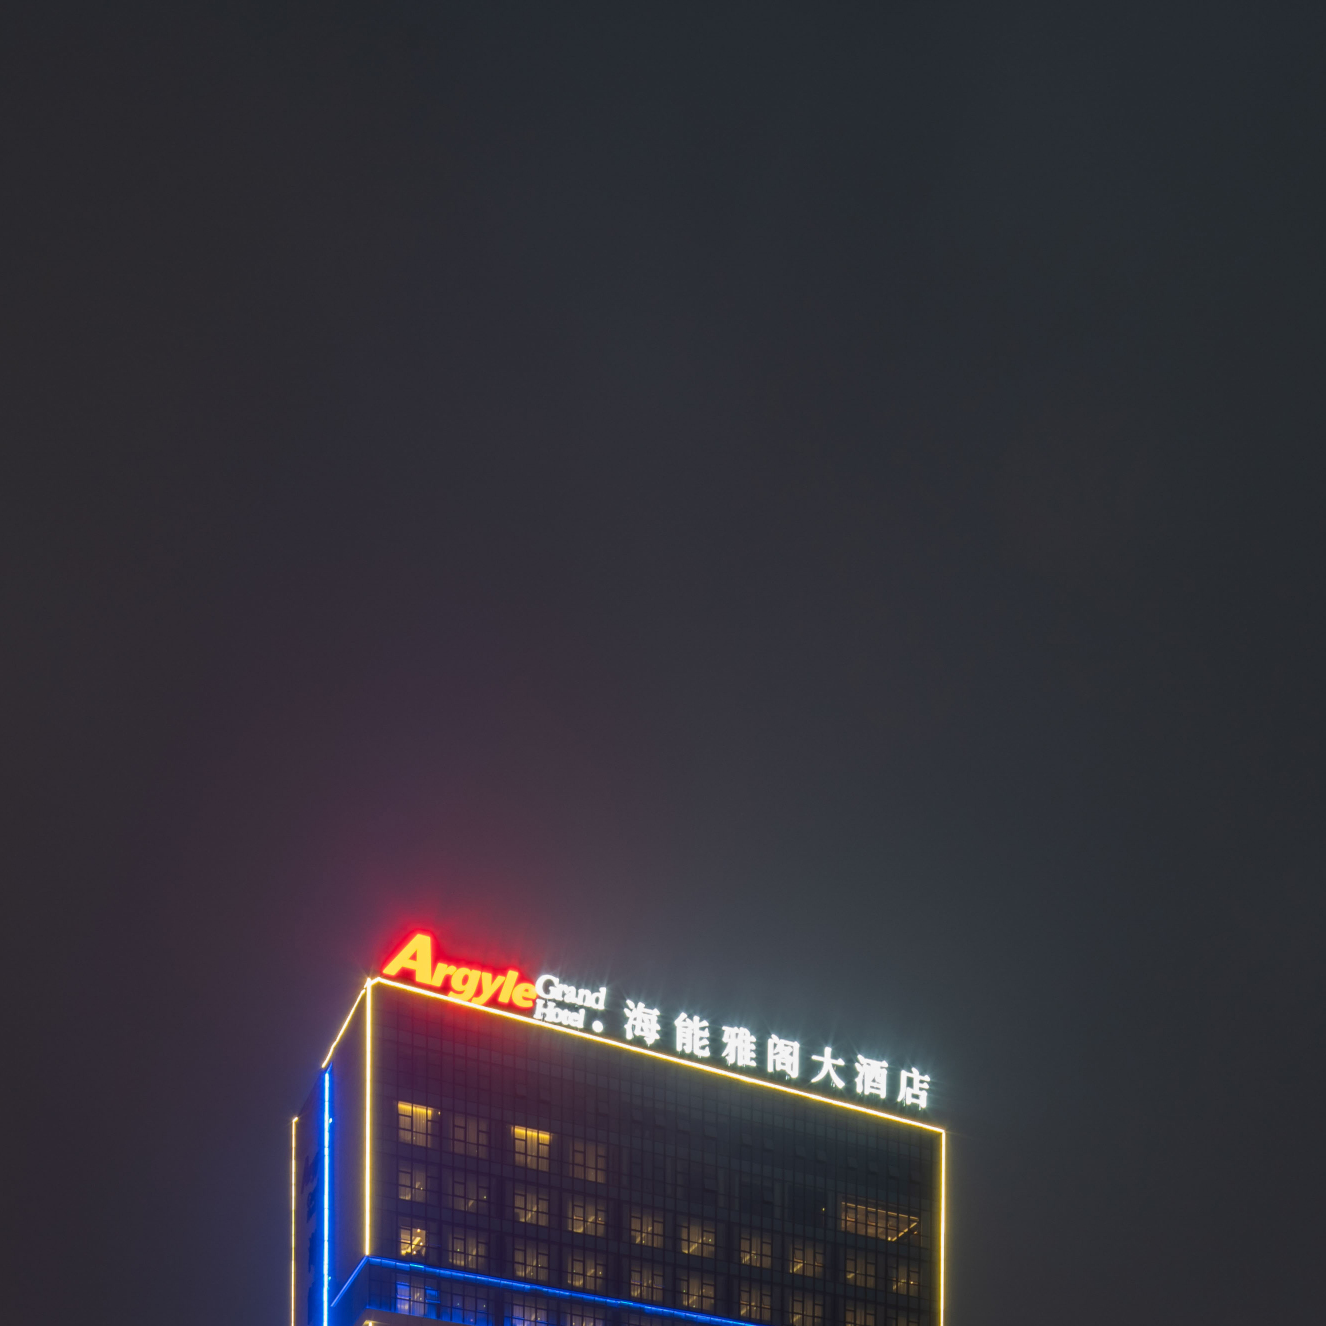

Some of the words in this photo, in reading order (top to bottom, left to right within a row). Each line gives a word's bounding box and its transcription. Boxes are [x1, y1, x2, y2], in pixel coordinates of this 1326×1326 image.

[383, 933, 537, 1008] Argyle
[535, 974, 607, 1010] Grand
[533, 998, 585, 1029] Hotel
[623, 998, 932, 1108] 海能雅阁大酒店
